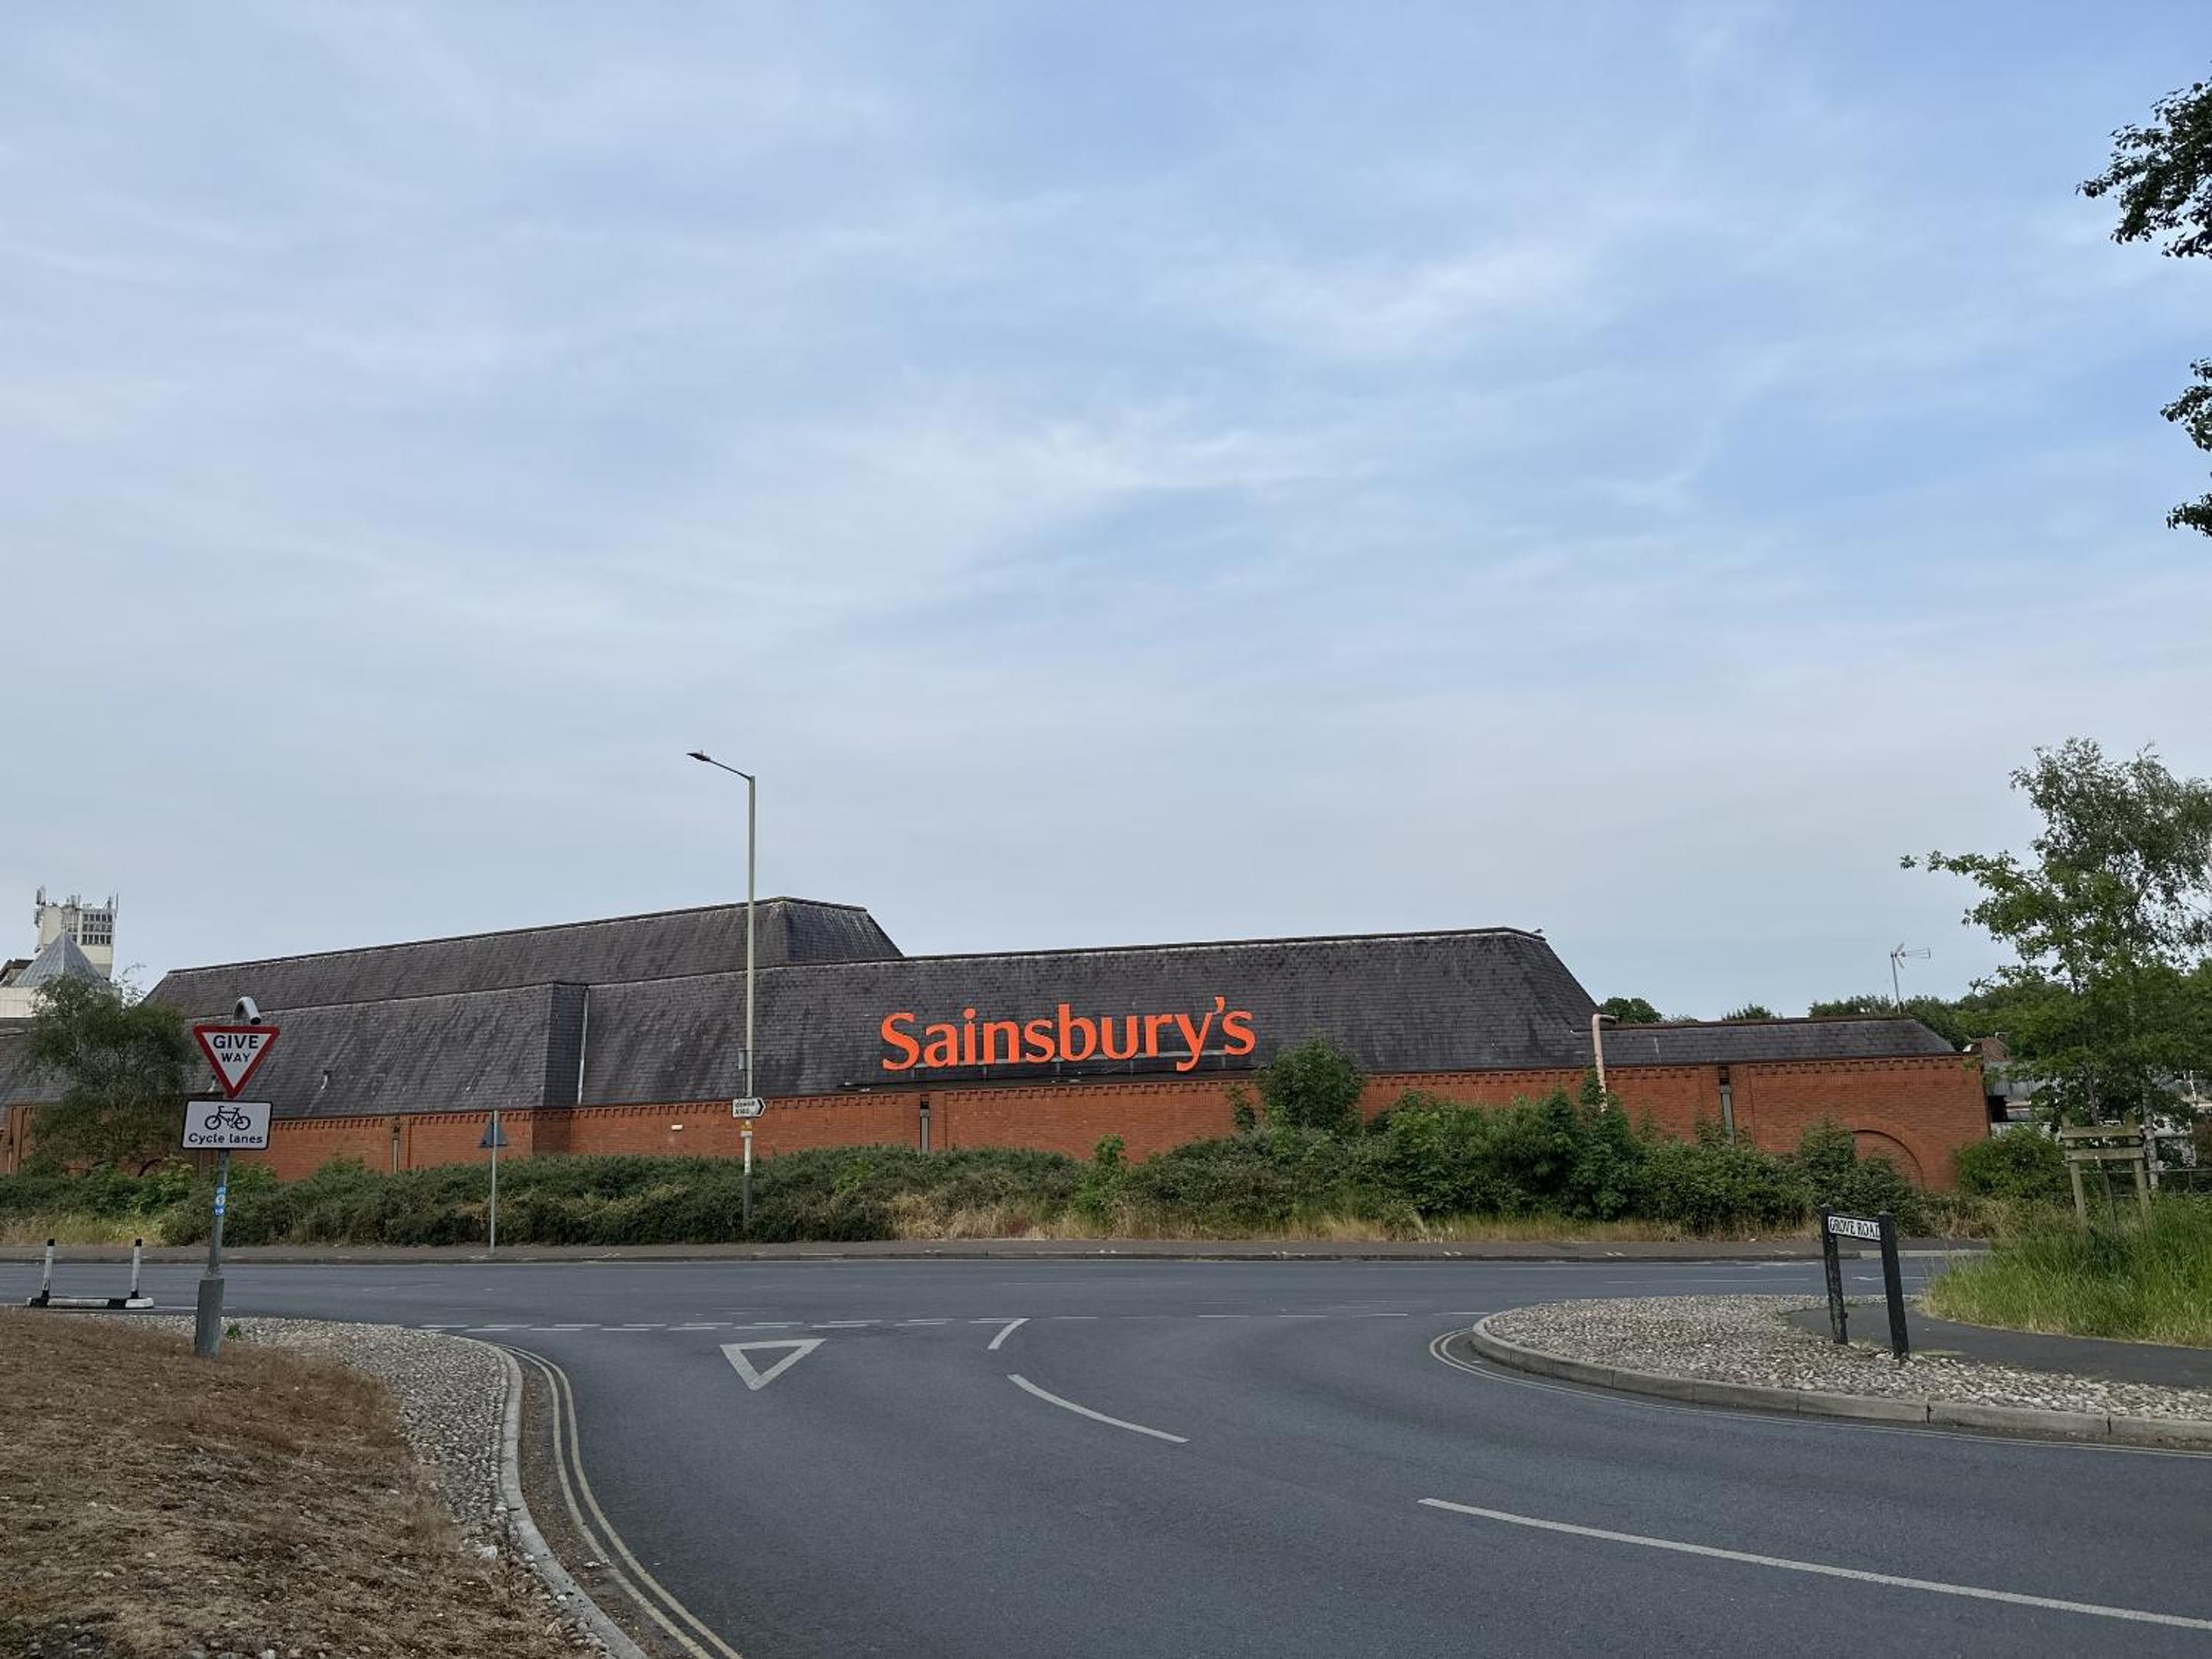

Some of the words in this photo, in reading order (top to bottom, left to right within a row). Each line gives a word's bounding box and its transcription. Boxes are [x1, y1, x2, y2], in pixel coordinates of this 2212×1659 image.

[880, 996, 1257, 1071] Sainsbury's
[213, 1035, 259, 1049] GIVE
[221, 1053, 251, 1062] WAY
[188, 1132, 225, 1145] Cycle
[230, 1133, 263, 1144] lanes
[1830, 1218, 1855, 1235] GROVE
